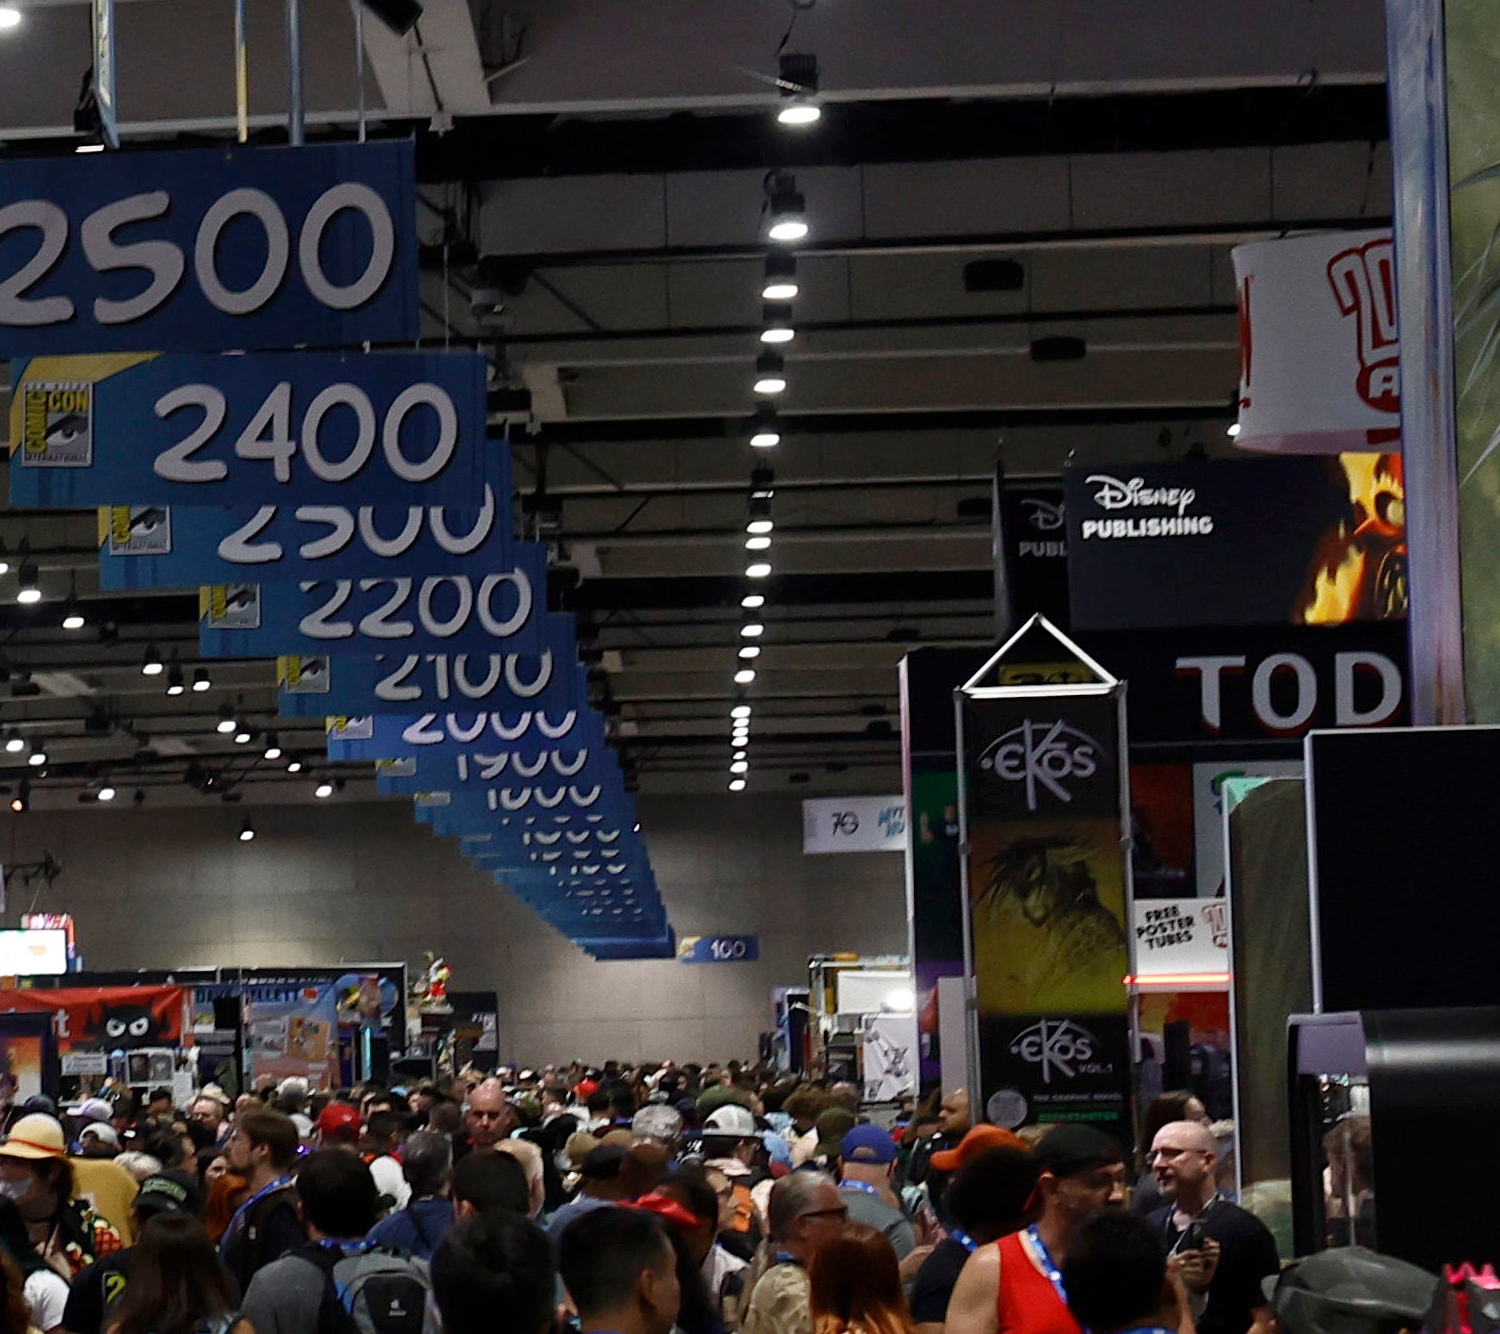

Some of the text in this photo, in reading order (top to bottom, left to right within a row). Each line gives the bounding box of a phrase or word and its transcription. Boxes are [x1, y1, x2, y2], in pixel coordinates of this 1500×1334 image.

[151, 380, 459, 485] 2400
[1080, 515, 1215, 540] PUBLISHING
[299, 567, 534, 640] 2200
[373, 647, 554, 702] 2100
[1145, 906, 1180, 922] FREE
[1136, 916, 1196, 939] POSTER
[709, 938, 748, 961] 100
[1144, 930, 1194, 950] TUBES
